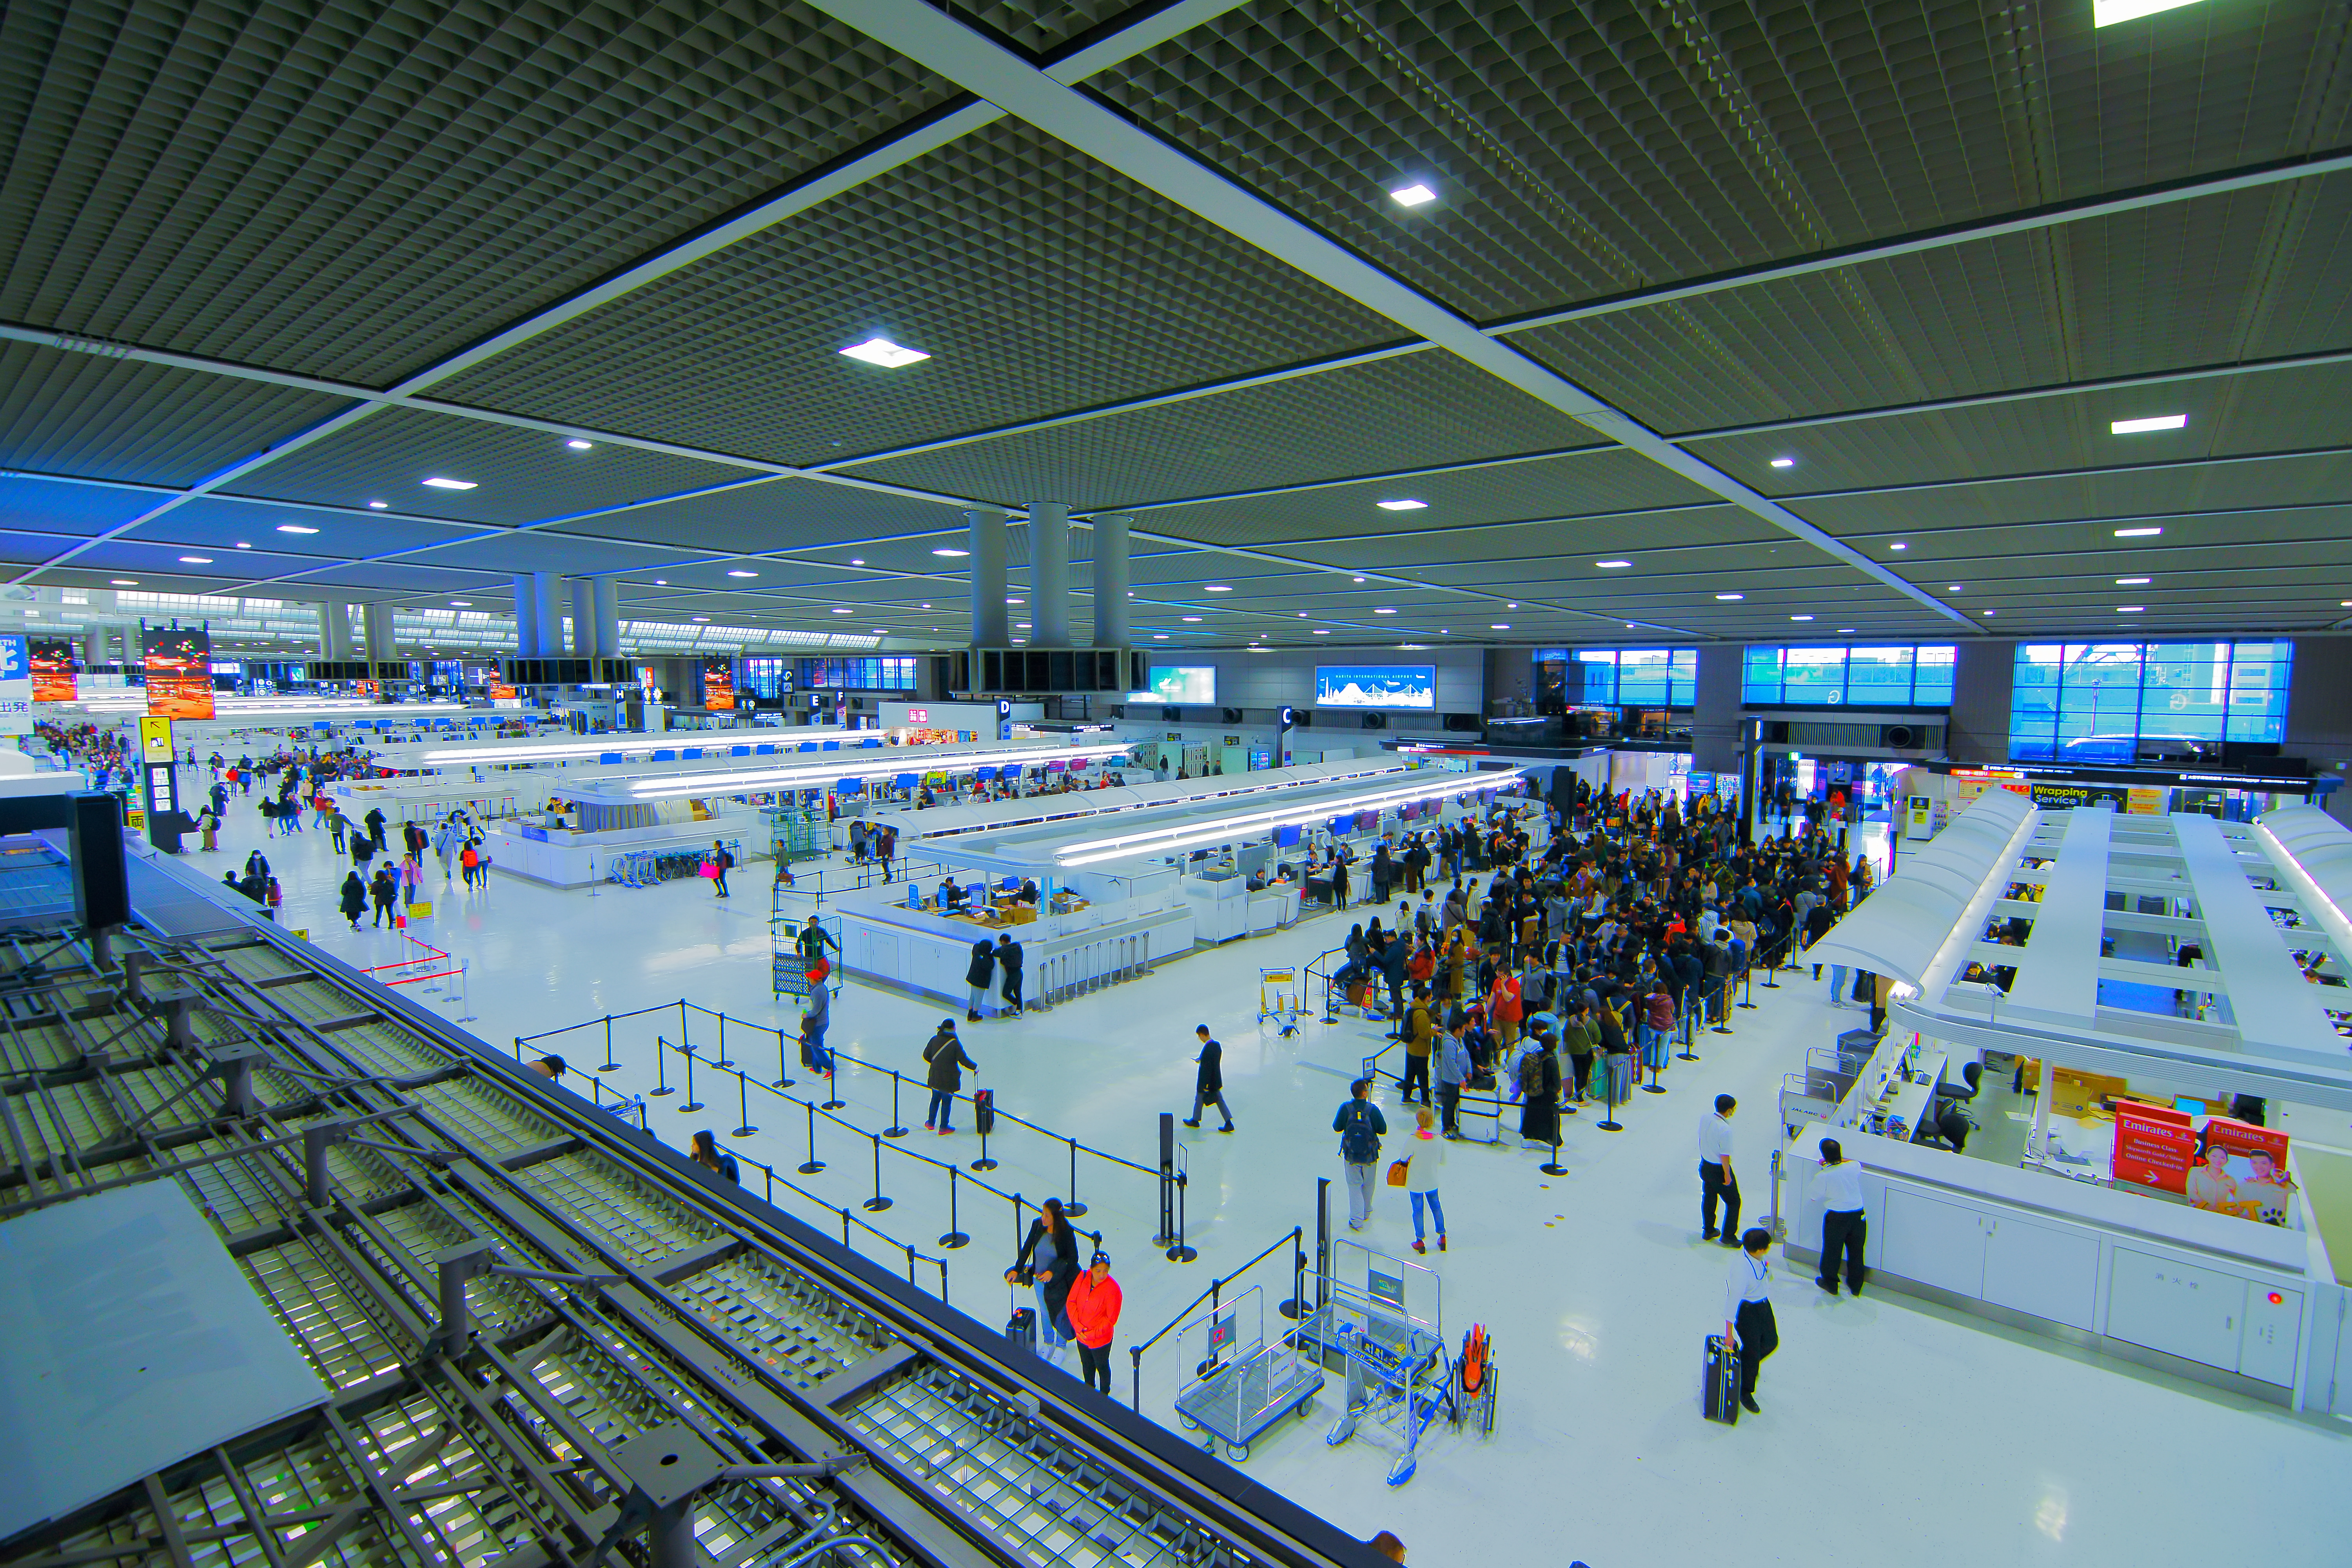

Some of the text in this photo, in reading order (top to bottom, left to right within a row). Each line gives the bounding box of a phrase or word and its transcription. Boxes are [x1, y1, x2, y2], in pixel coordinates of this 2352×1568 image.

[617, 690, 624, 699] H
[812, 695, 819, 706] E
[838, 691, 844, 701] F
[1001, 701, 1009, 713] D
[1283, 708, 1290, 723] C
[1755, 721, 1761, 740] B
[1833, 766, 1846, 782] 2
[2034, 786, 2088, 797] Wrapping
[2035, 795, 2076, 804] Service
[2123, 1119, 2172, 1137] Emirates
[2213, 1125, 2264, 1142] Emirates
[2125, 1145, 2151, 1155] Skywards
[2134, 1138, 2177, 1153] Business Class
[2223, 1142, 2251, 1154] Economy
[2125, 1153, 2183, 1171] Online Checked-in
[1279, 1363, 1289, 1372] ABC
